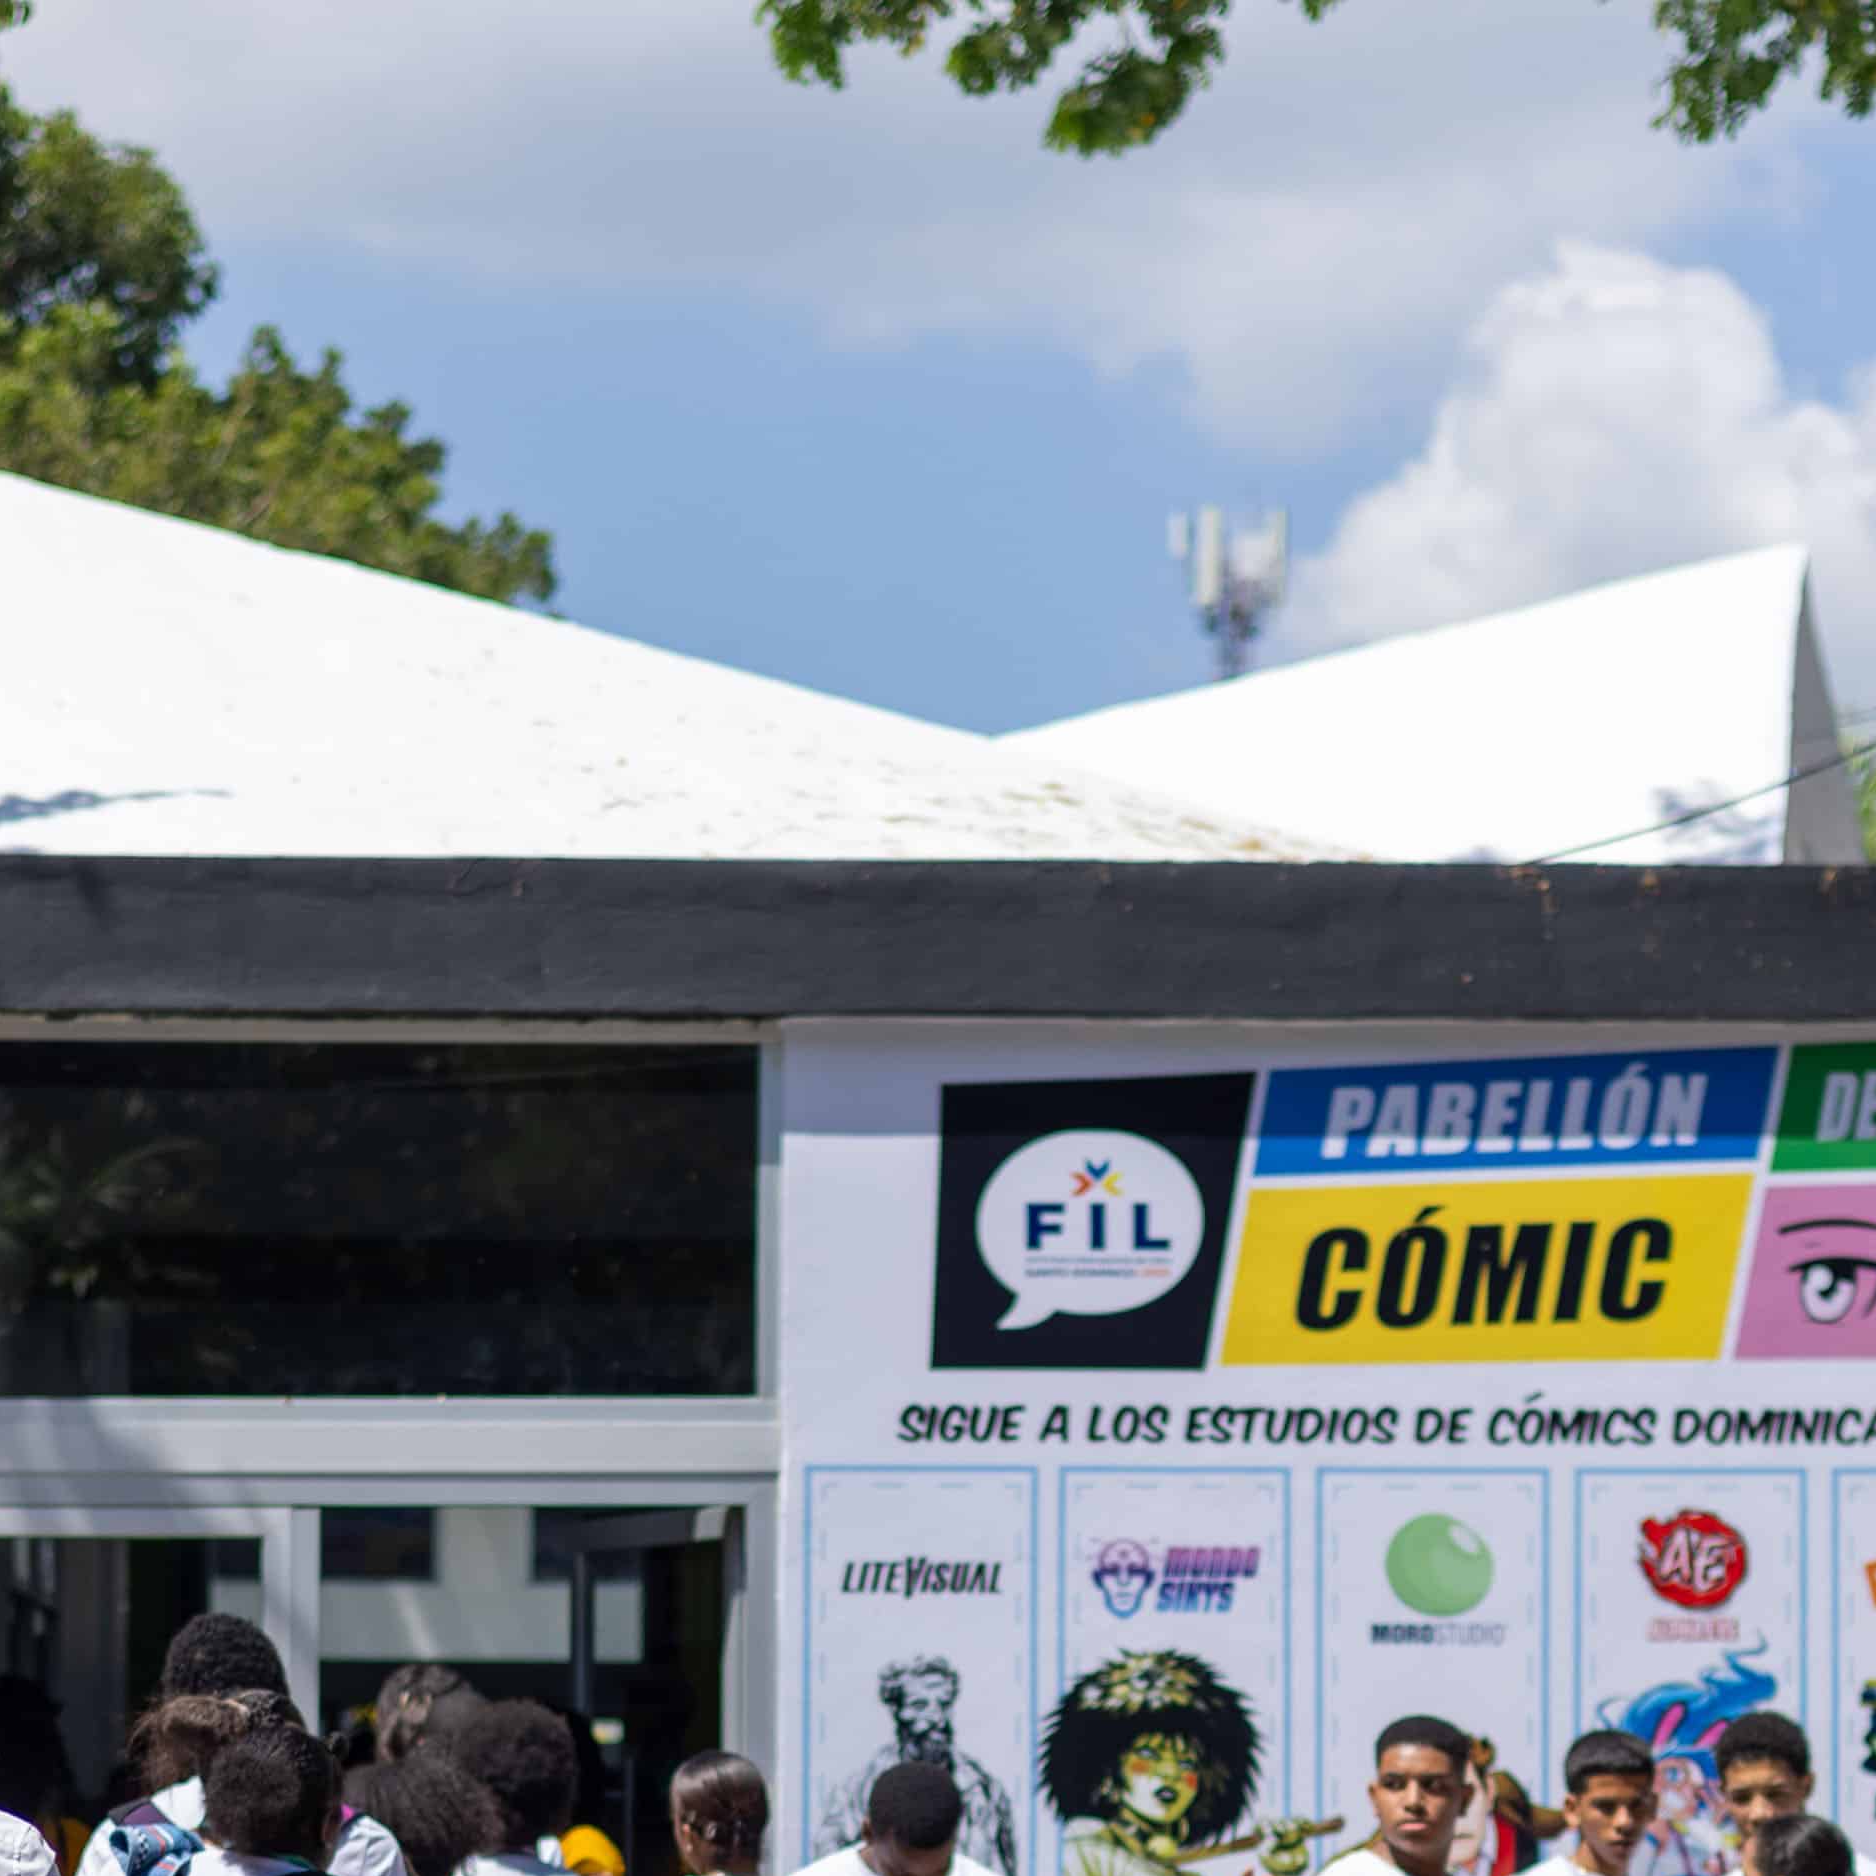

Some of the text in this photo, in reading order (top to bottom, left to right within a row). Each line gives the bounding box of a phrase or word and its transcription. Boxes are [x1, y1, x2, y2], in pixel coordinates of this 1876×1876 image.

[1320, 1063, 1709, 1160] PABELLÓN
[1026, 1202, 1172, 1250] FIL
[1296, 1204, 1673, 1332] CÓMIC
[897, 1403, 1026, 1444] SIGUE
[1038, 1404, 1070, 1442] A
[1086, 1403, 1171, 1444] LOS
[1184, 1404, 1400, 1445] ESTUDIOS
[1414, 1406, 1473, 1445] DE
[1486, 1392, 1658, 1446] CÓMICS
